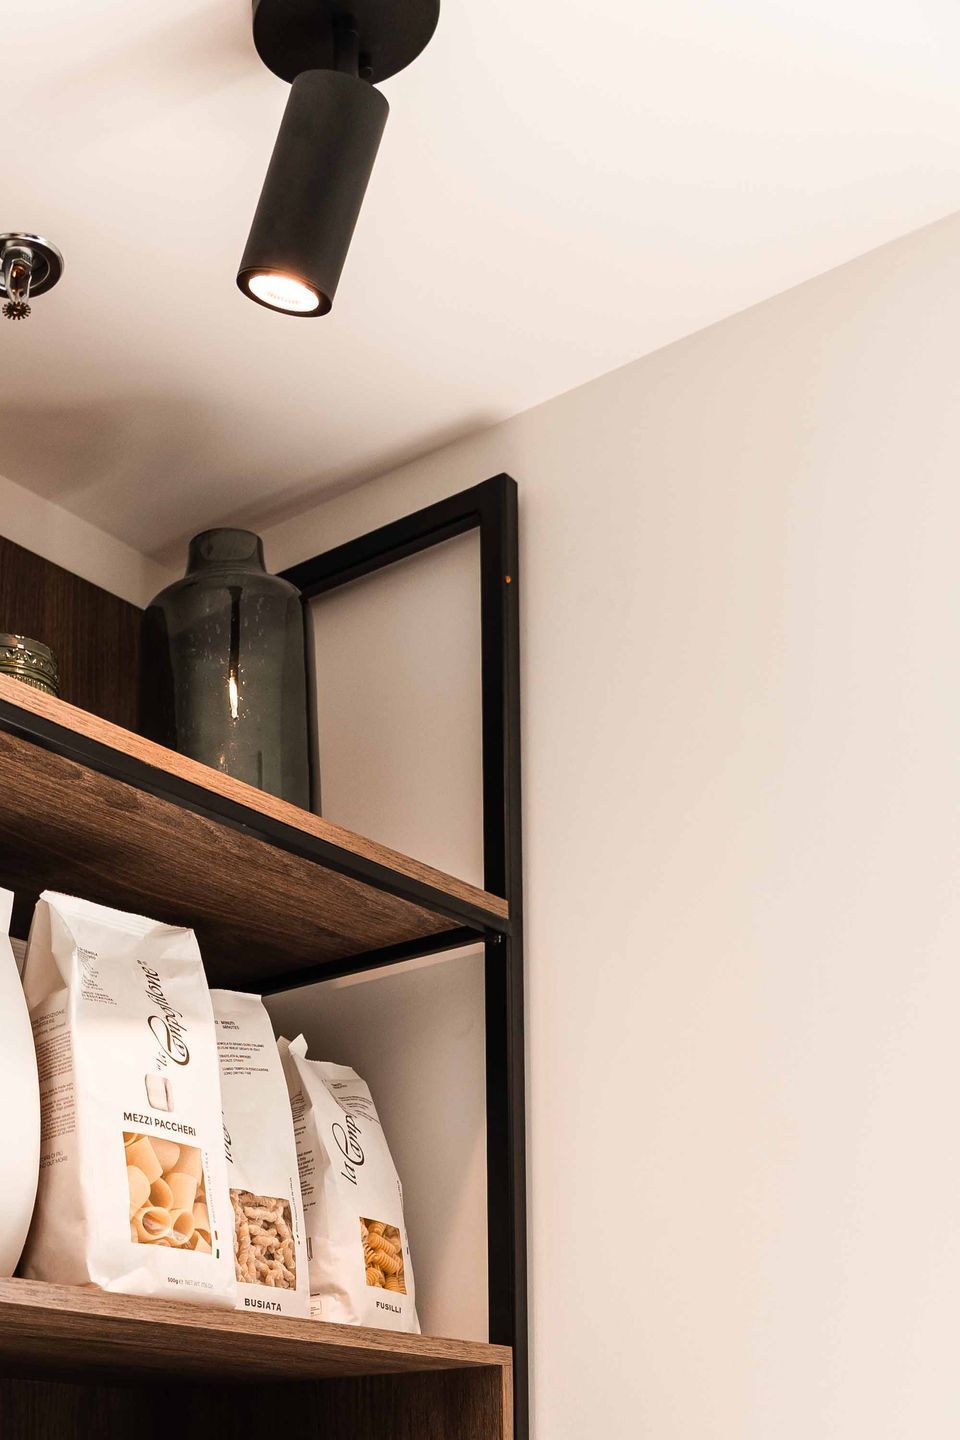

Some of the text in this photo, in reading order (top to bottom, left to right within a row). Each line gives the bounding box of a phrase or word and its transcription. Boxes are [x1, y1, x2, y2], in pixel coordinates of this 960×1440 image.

[123, 1112, 197, 1136] MEZZI PACCHERI
[341, 1161, 357, 1185] la
[244, 1298, 282, 1312] BUSIATA
[376, 1301, 402, 1314] FUSILLI
